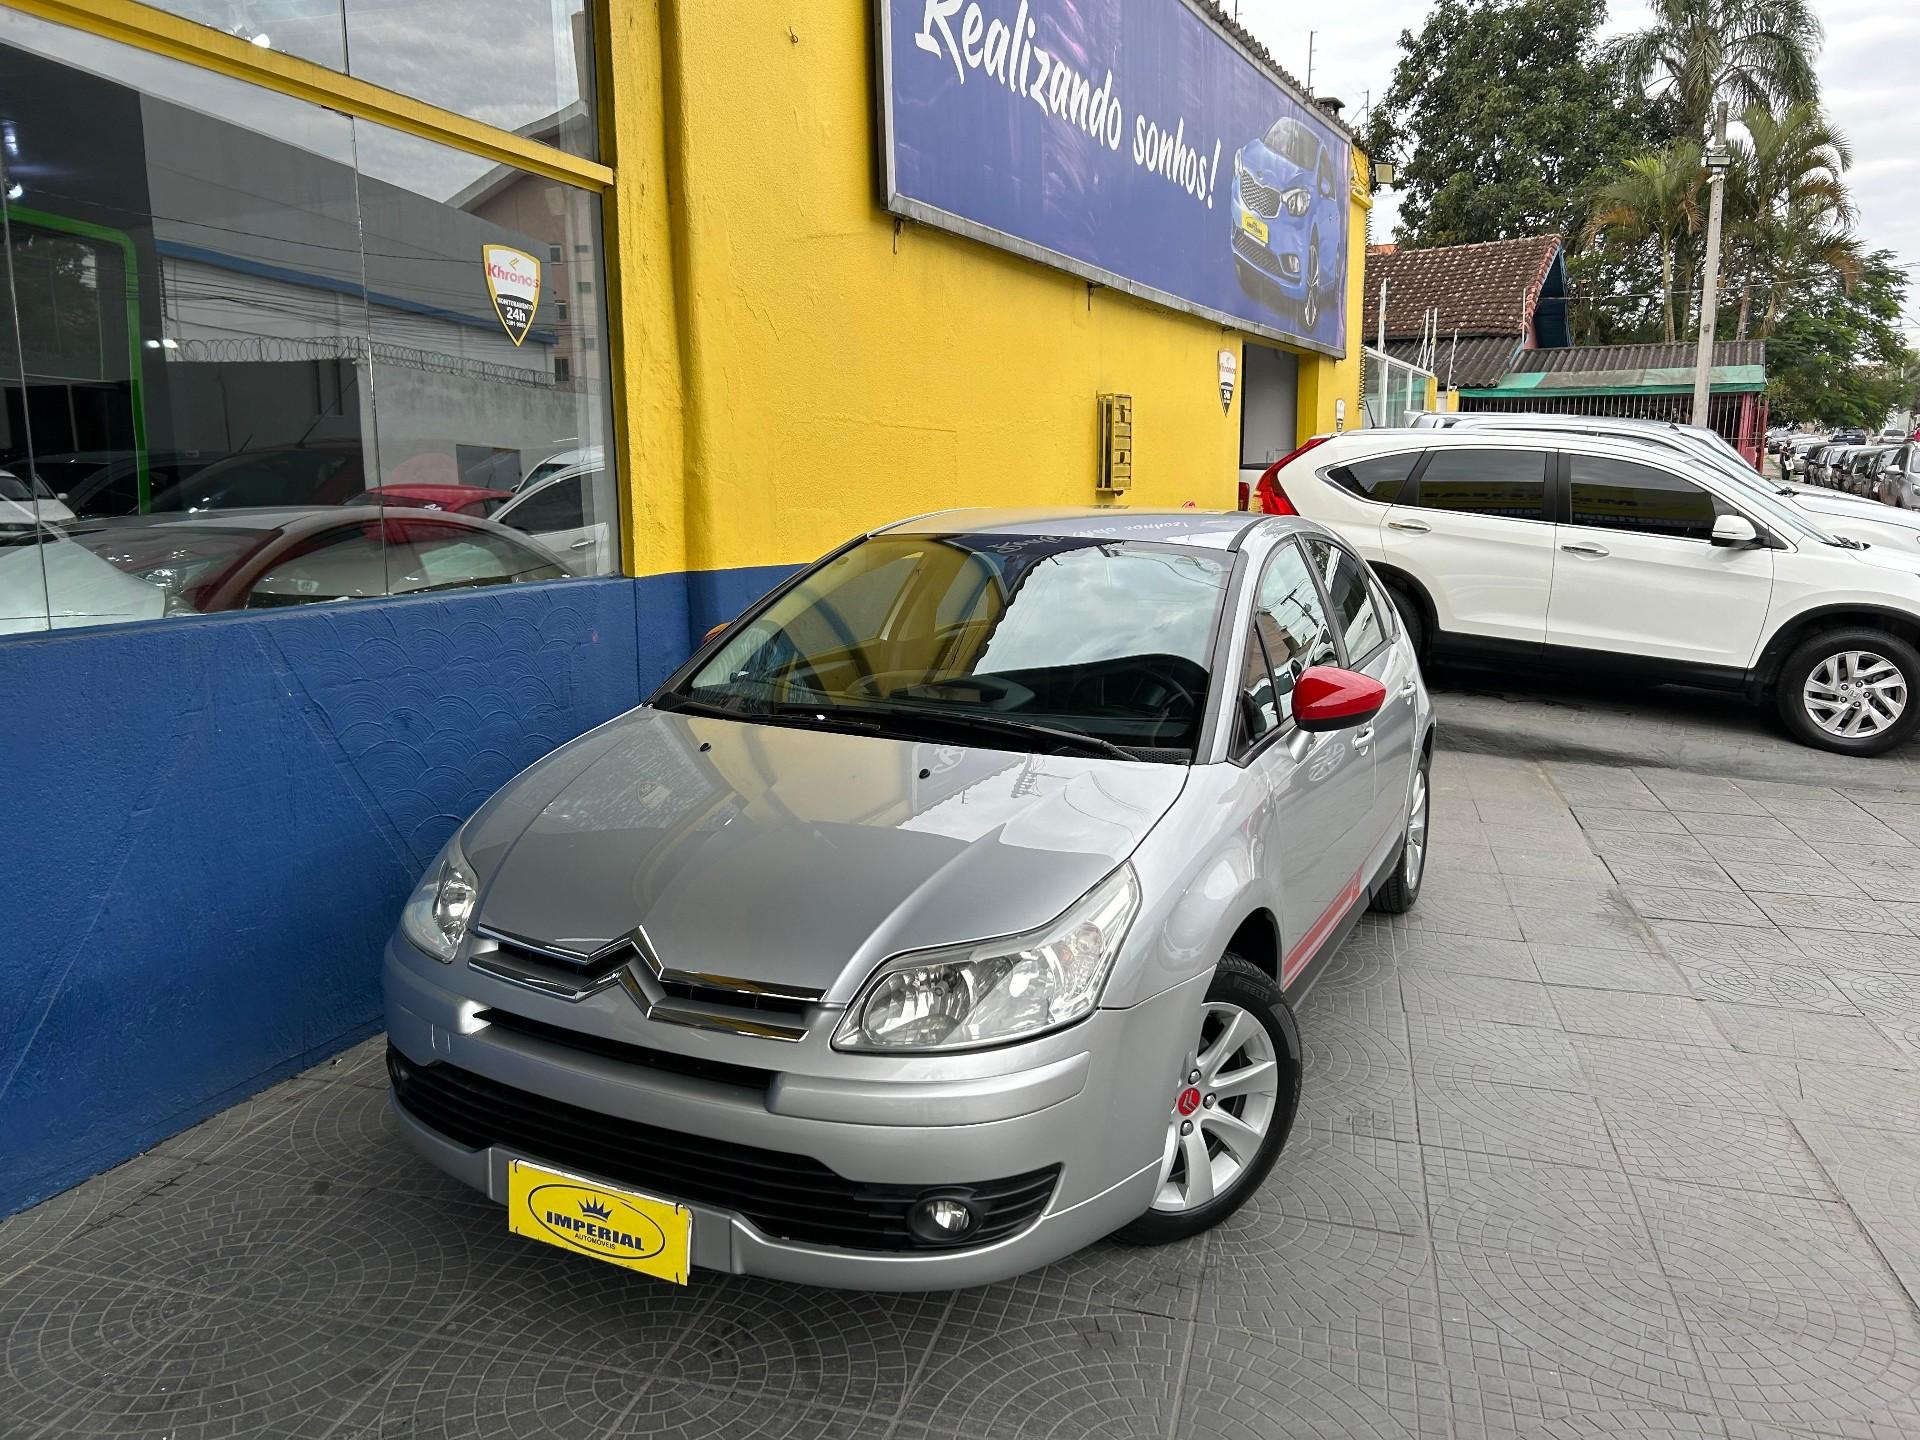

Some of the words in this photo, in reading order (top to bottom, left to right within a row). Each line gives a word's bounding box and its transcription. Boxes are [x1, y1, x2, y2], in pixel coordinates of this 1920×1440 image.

[915, 0, 1122, 150] Realizando
[1133, 114, 1222, 210] sonhos!
[488, 263, 540, 288] Khronos
[506, 307, 526, 322] 24h
[547, 1211, 645, 1251] IMPERIAL
